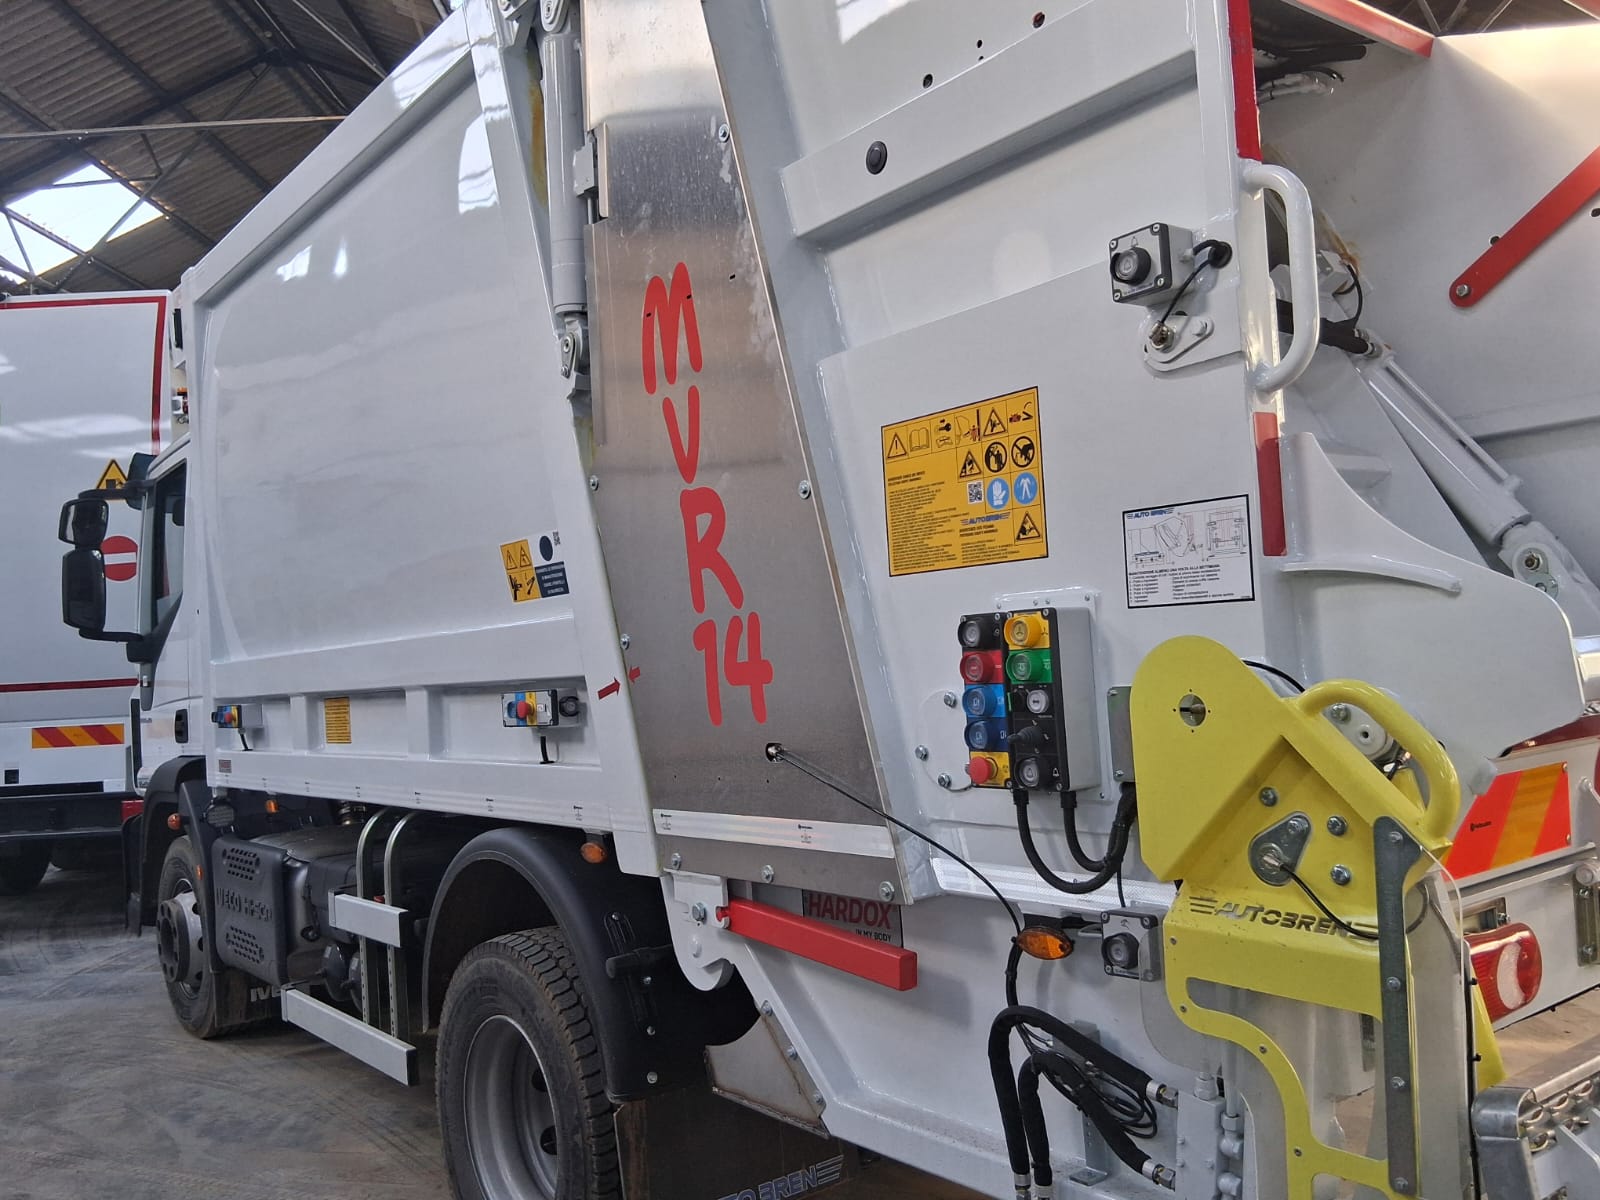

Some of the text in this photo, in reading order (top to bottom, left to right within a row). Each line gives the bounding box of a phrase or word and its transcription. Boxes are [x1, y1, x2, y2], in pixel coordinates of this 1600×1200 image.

[693, 611, 774, 727] 14
[808, 892, 892, 930] HARDOX
[863, 930, 873, 940] MY
[873, 932, 892, 943] BODY
